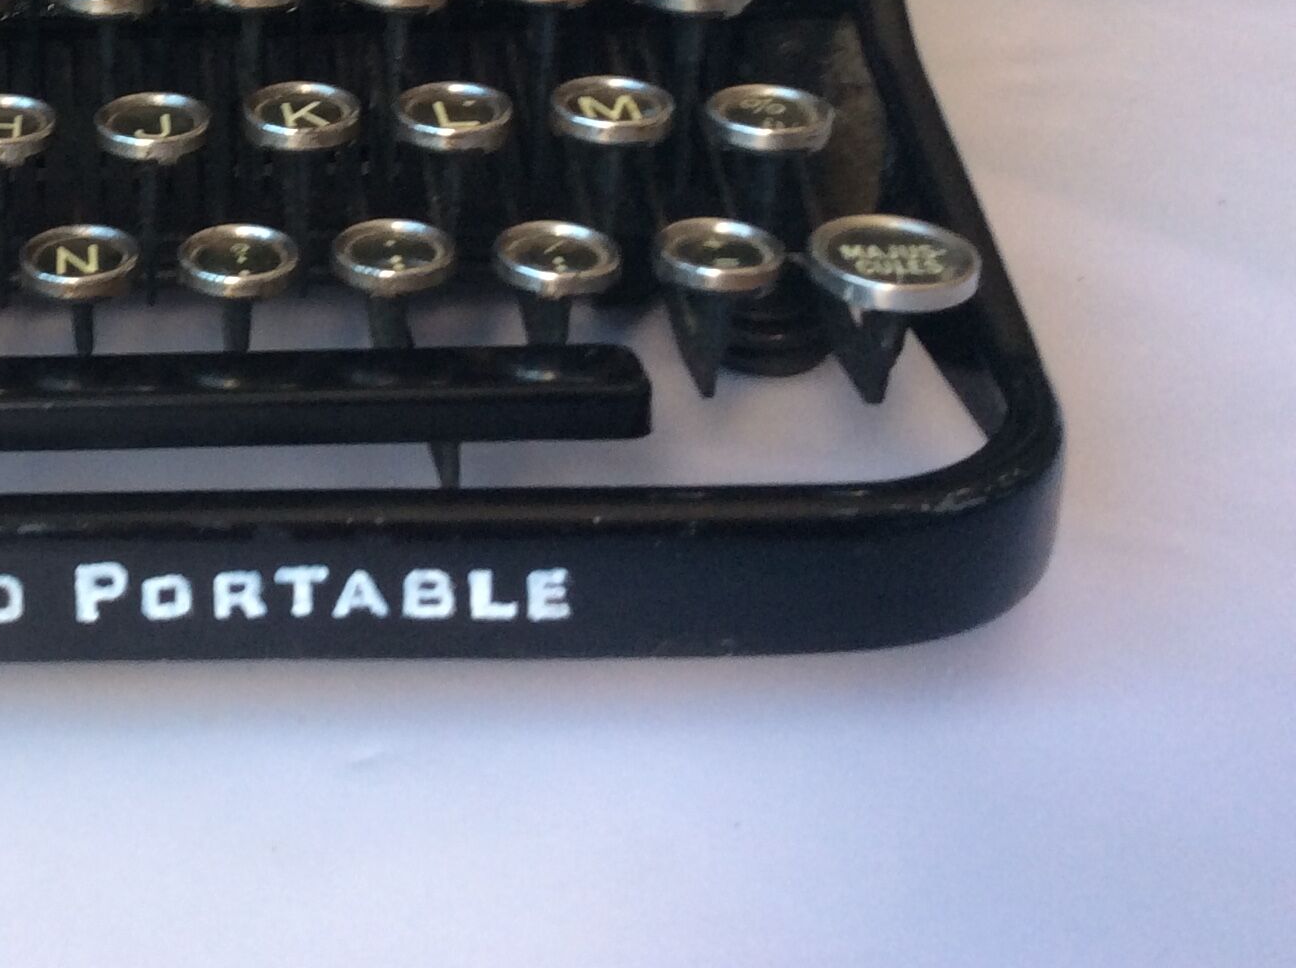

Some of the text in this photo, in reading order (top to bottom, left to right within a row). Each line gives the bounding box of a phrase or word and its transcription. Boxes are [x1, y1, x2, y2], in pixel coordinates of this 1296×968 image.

[279, 101, 331, 130] K
[431, 99, 481, 130] L
[577, 94, 643, 122] M
[133, 113, 172, 141] J
[55, 243, 100, 277] N
[73, 560, 573, 624] PORTABLE
